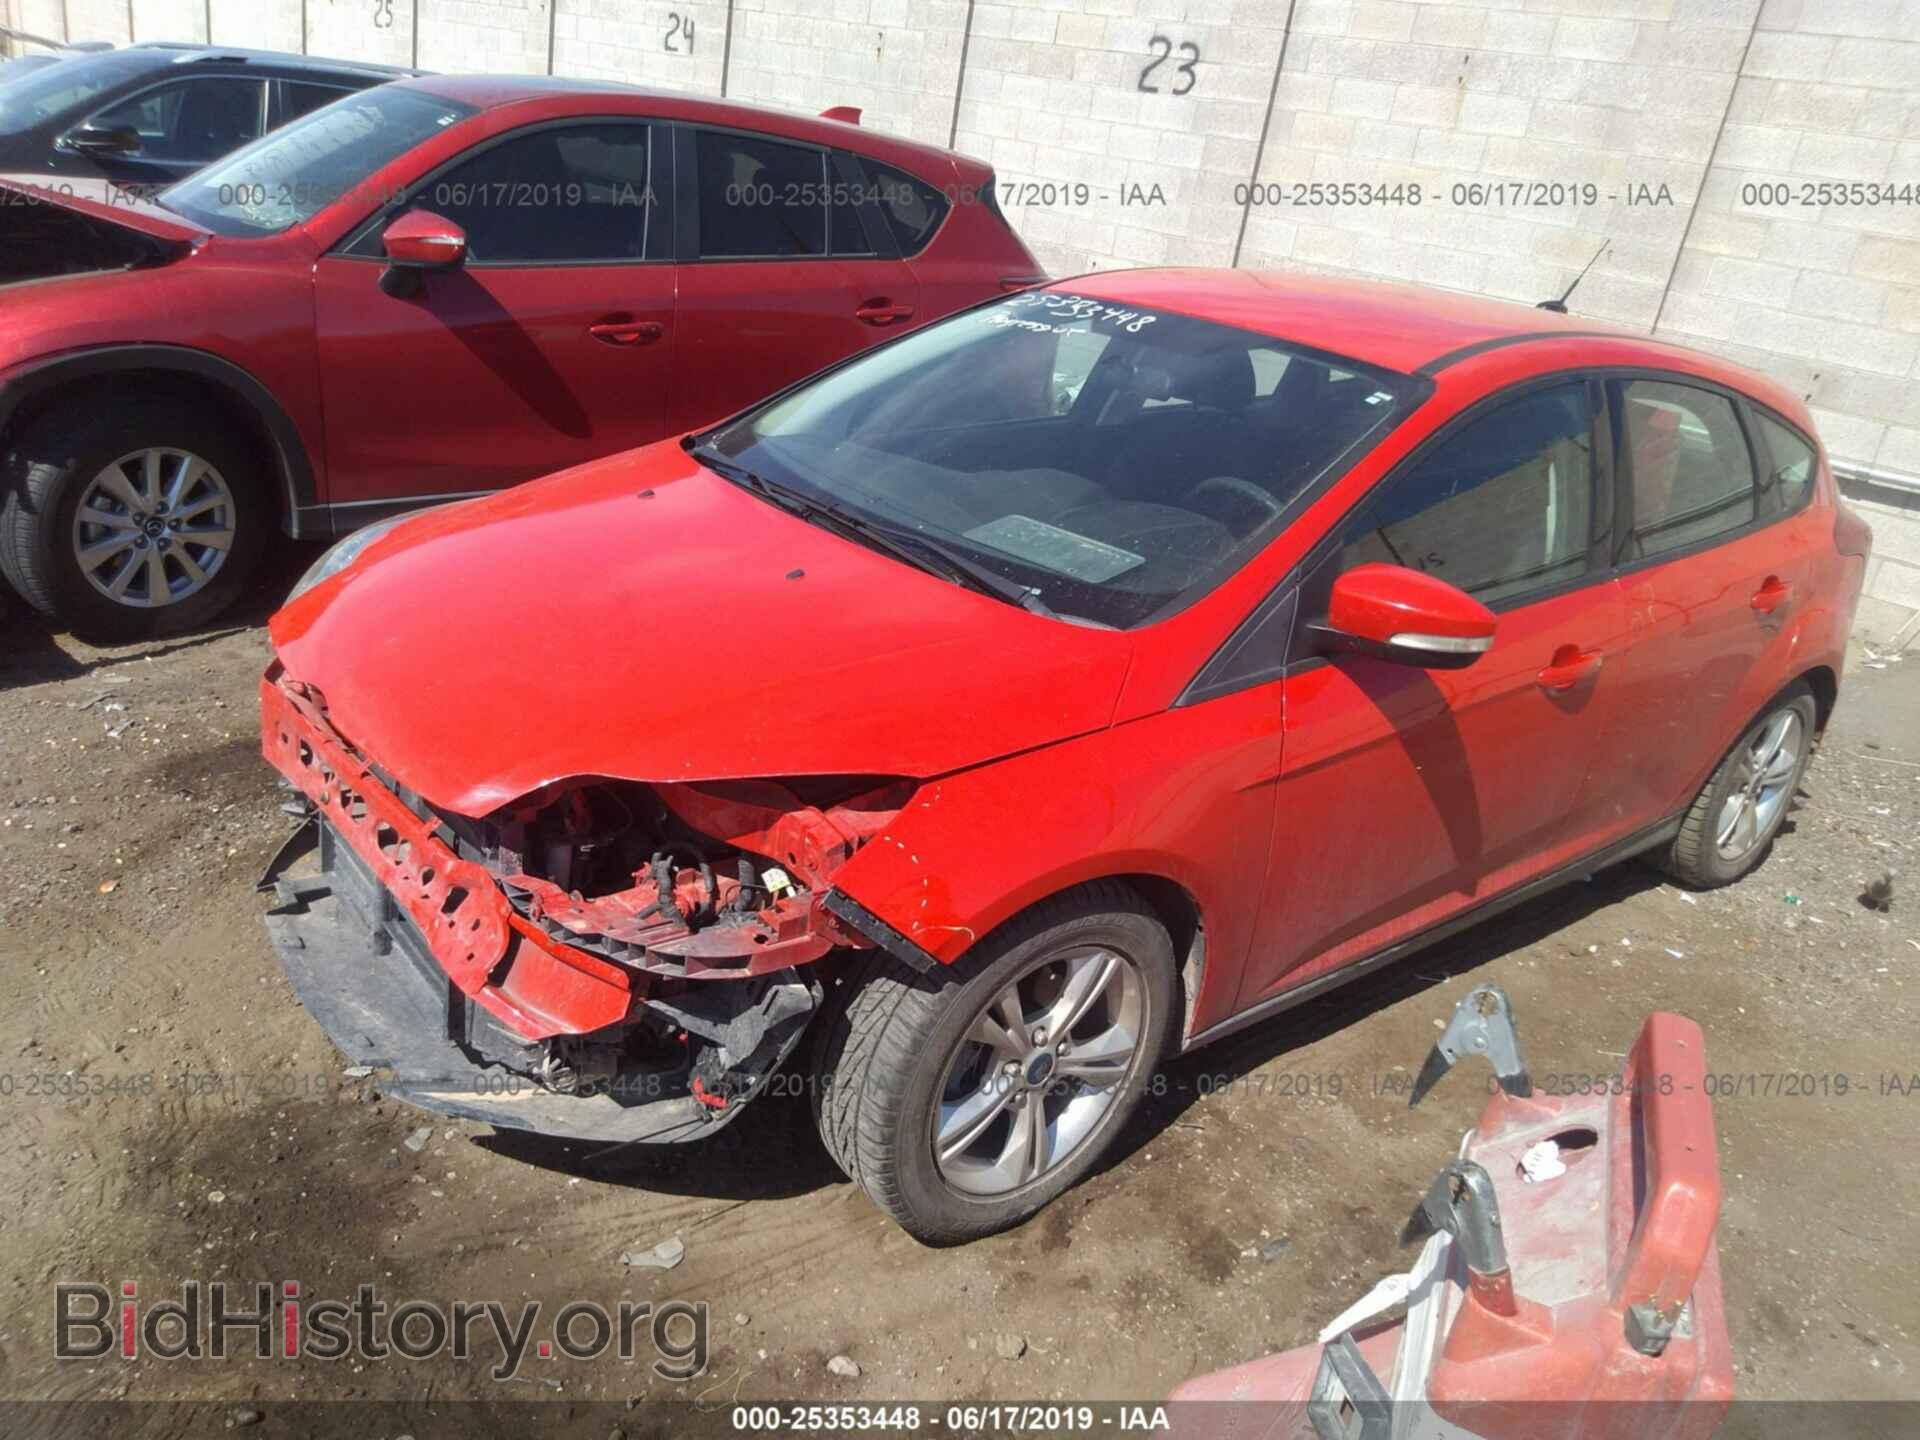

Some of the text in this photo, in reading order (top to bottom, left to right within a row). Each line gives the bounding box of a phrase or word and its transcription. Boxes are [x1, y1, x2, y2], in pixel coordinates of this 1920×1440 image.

[373, 0, 393, 28] 25
[664, 12, 695, 54] 24
[1137, 34, 1200, 95] 23
